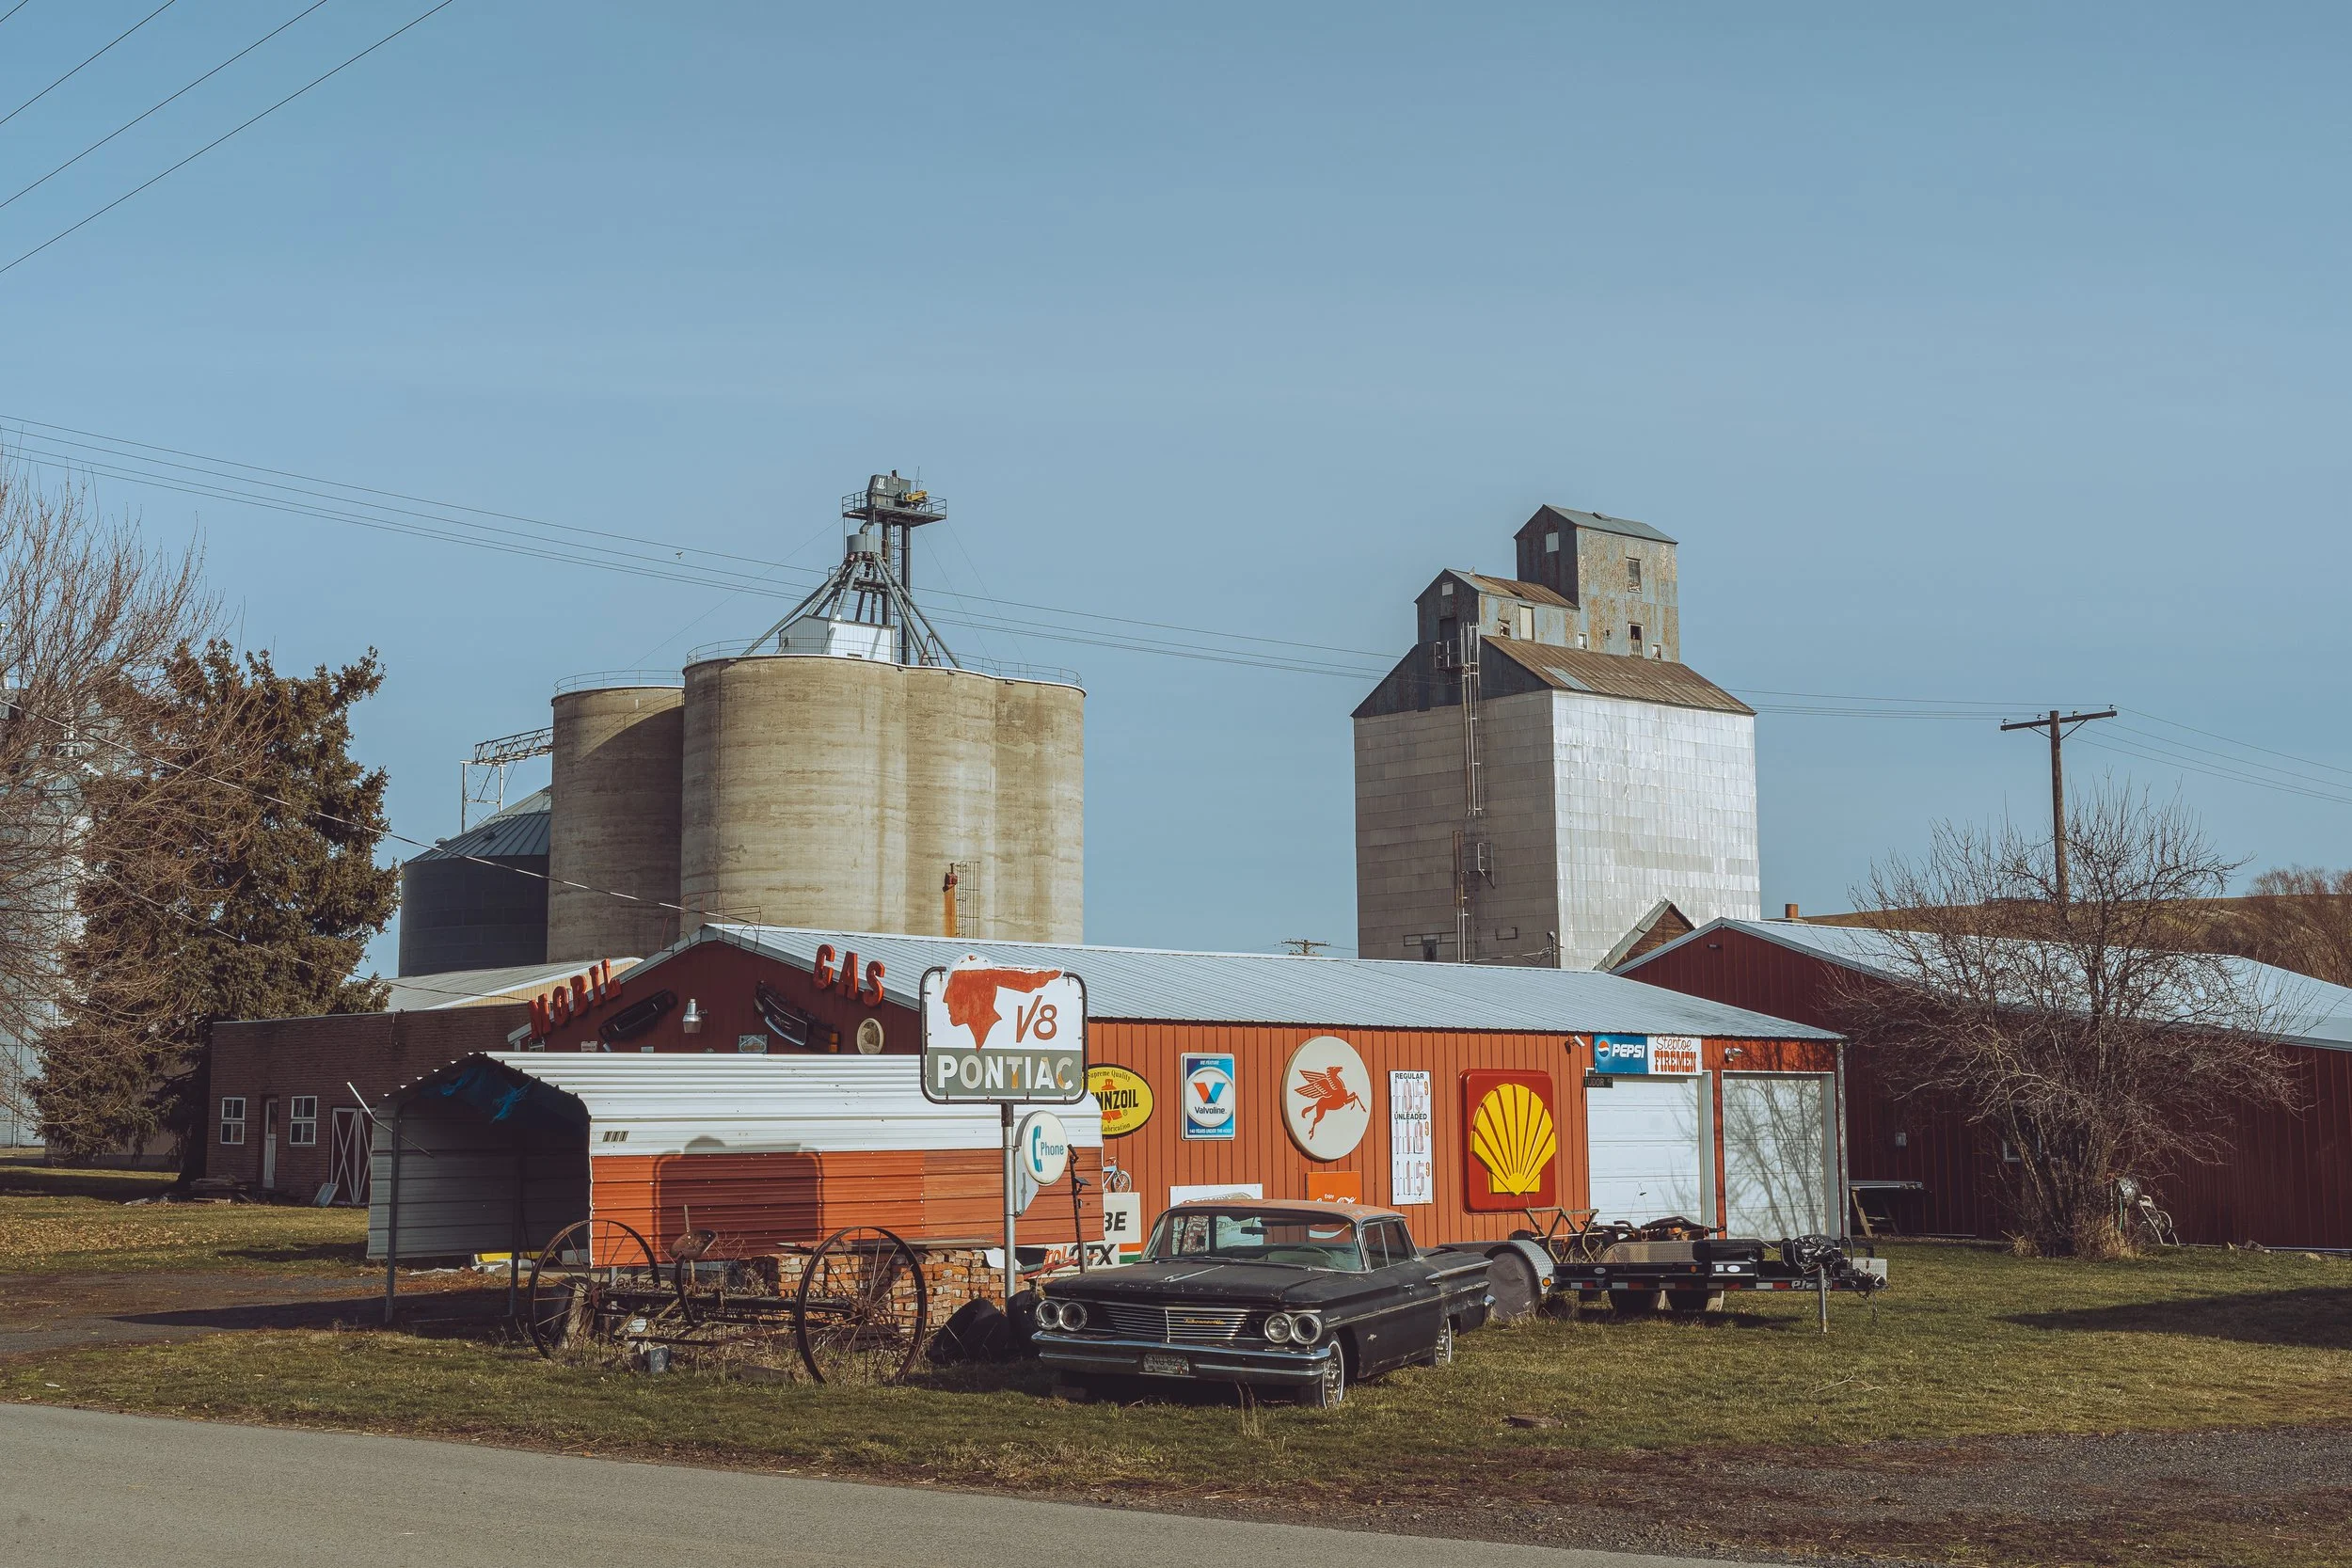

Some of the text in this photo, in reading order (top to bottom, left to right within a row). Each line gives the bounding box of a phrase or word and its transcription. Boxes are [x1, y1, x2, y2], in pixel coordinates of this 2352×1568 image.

[529, 943, 885, 1038] MOBIL GAS
[1016, 994, 1057, 1043] V8
[1612, 1043, 1645, 1058] PEPSI
[1656, 1034, 1692, 1052] Steptoe
[1654, 1050, 1696, 1072] FIREMEN
[937, 1054, 1074, 1090] PONTIAC
[1111, 1069, 1131, 1082] Quality
[1584, 1077, 1605, 1086] TUDOR
[1091, 1088, 1139, 1111] NNZOIL
[1194, 1106, 1226, 1115] Valvoline
[1041, 1141, 1064, 1156] Phone
[1104, 1212, 1127, 1231] BE
[1044, 1245, 1068, 1264] rol
